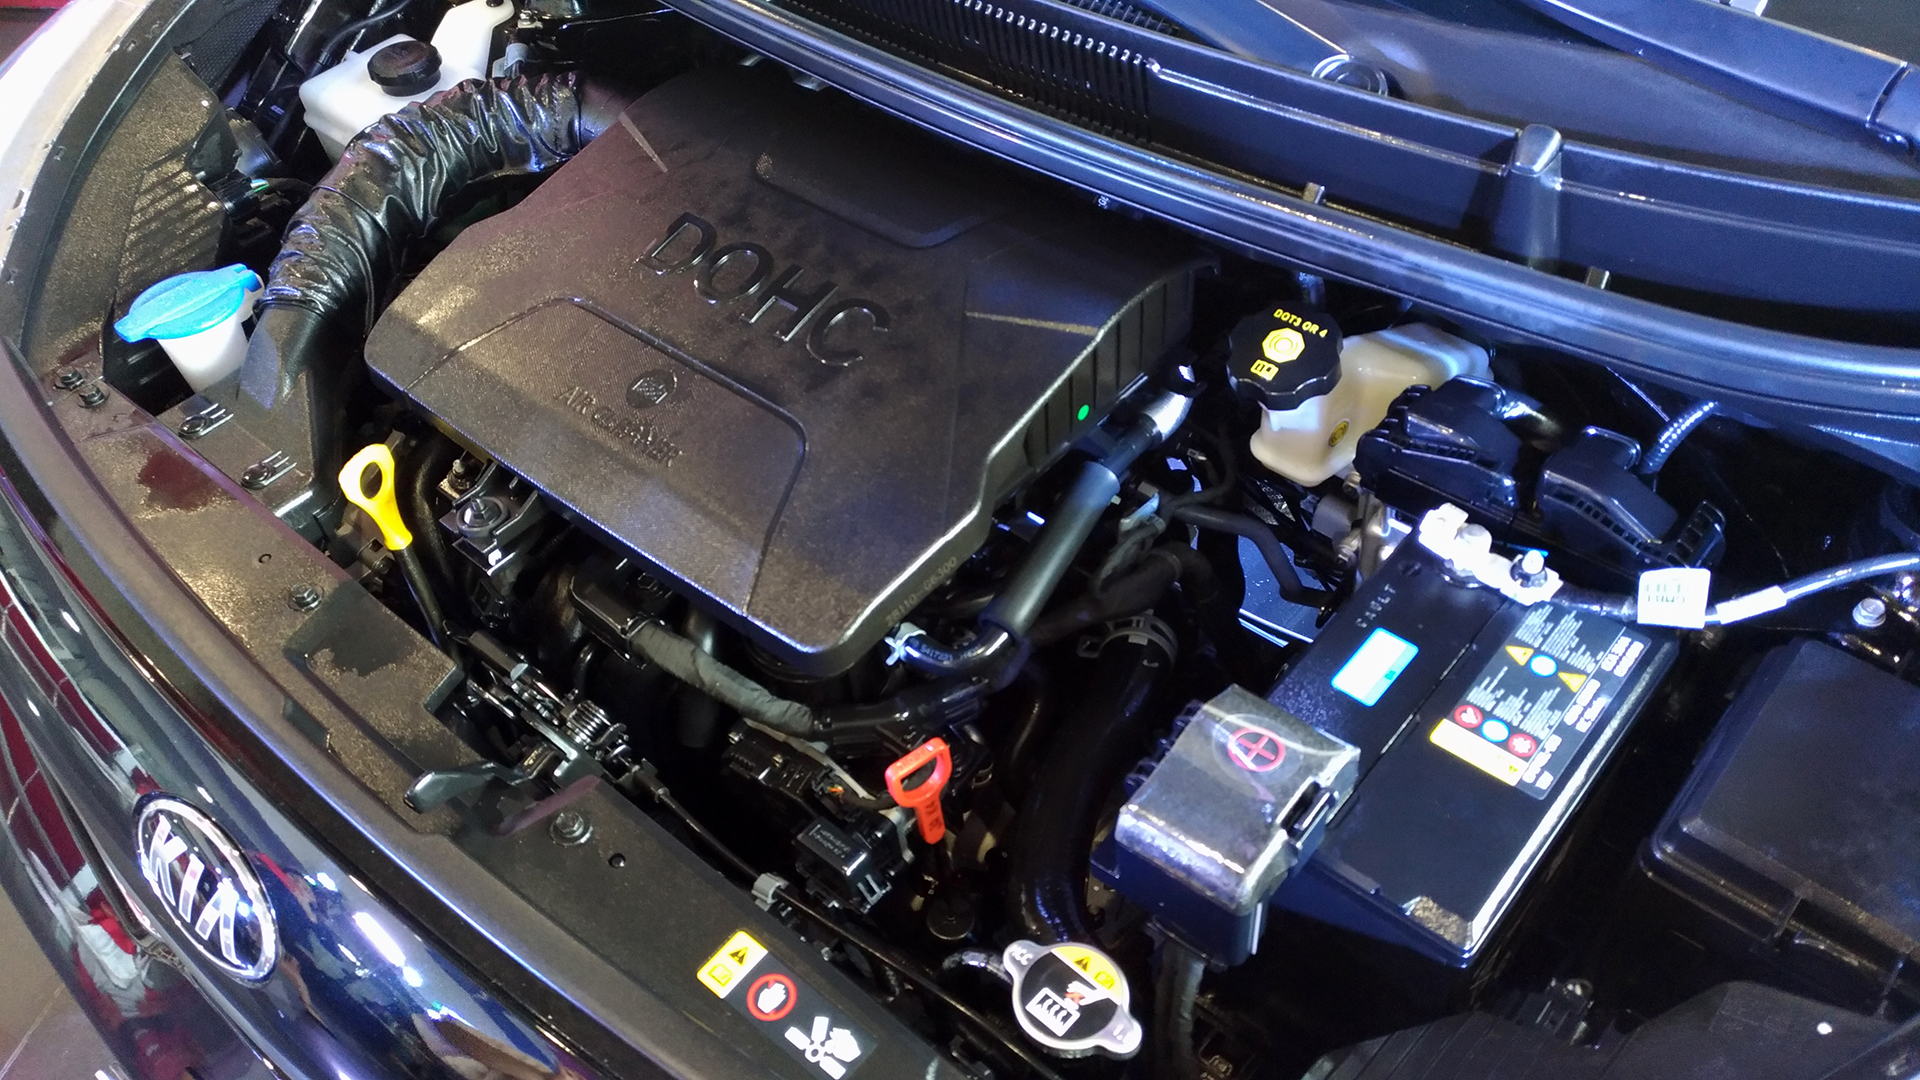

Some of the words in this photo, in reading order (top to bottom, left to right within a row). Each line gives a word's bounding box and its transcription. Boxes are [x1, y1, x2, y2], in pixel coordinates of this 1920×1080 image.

[638, 211, 890, 366] DOHC
[1273, 308, 1302, 327] DOT3
[1302, 321, 1320, 335] OR
[1319, 329, 1328, 338] 4
[150, 814, 242, 965] KIA
